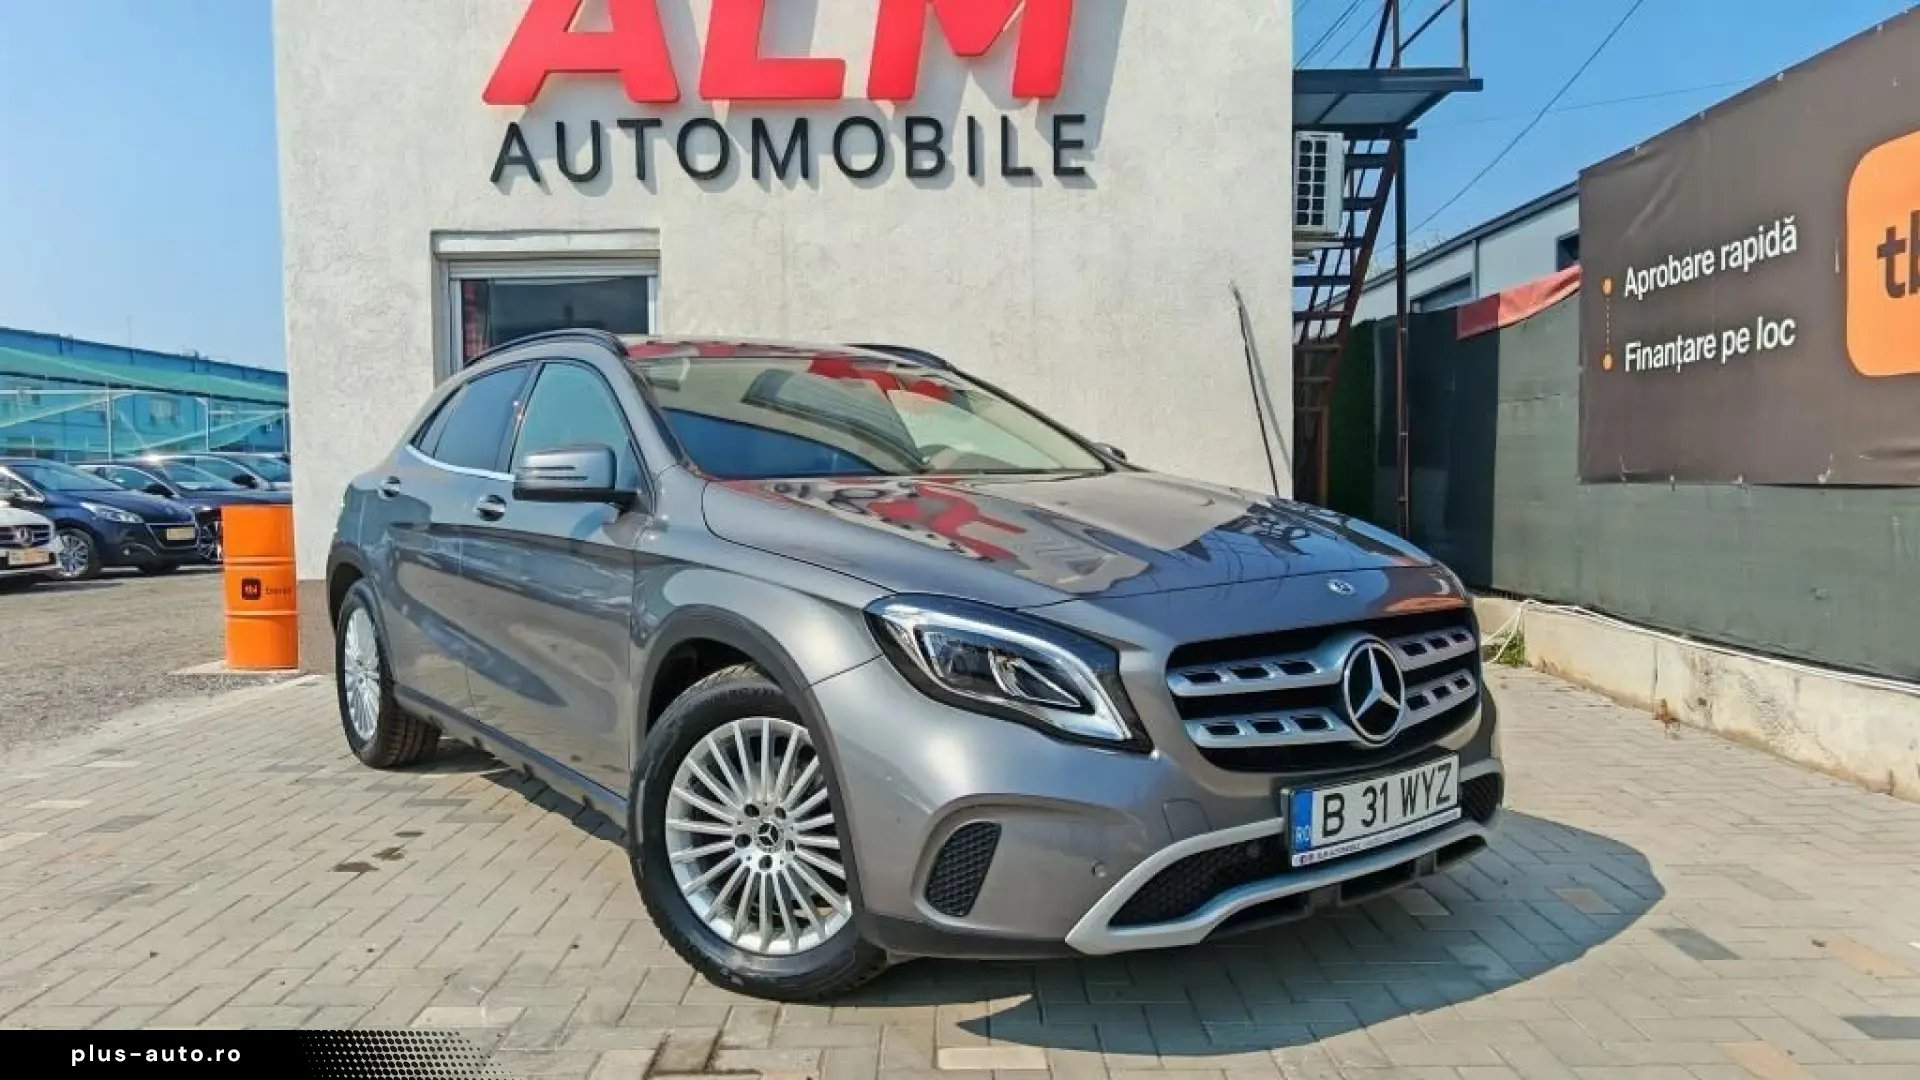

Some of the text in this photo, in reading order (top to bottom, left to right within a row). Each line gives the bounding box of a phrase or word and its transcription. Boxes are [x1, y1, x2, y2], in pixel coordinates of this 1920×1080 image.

[482, 0, 1073, 103] ALM
[490, 114, 1087, 184] AUTOMOBILE
[1624, 215, 1798, 300] Aprobare rapidă
[1625, 316, 1796, 373] Finanțare pe loc
[1322, 792, 1345, 838] B
[1361, 781, 1389, 828] 31
[1400, 762, 1452, 818] WYZ
